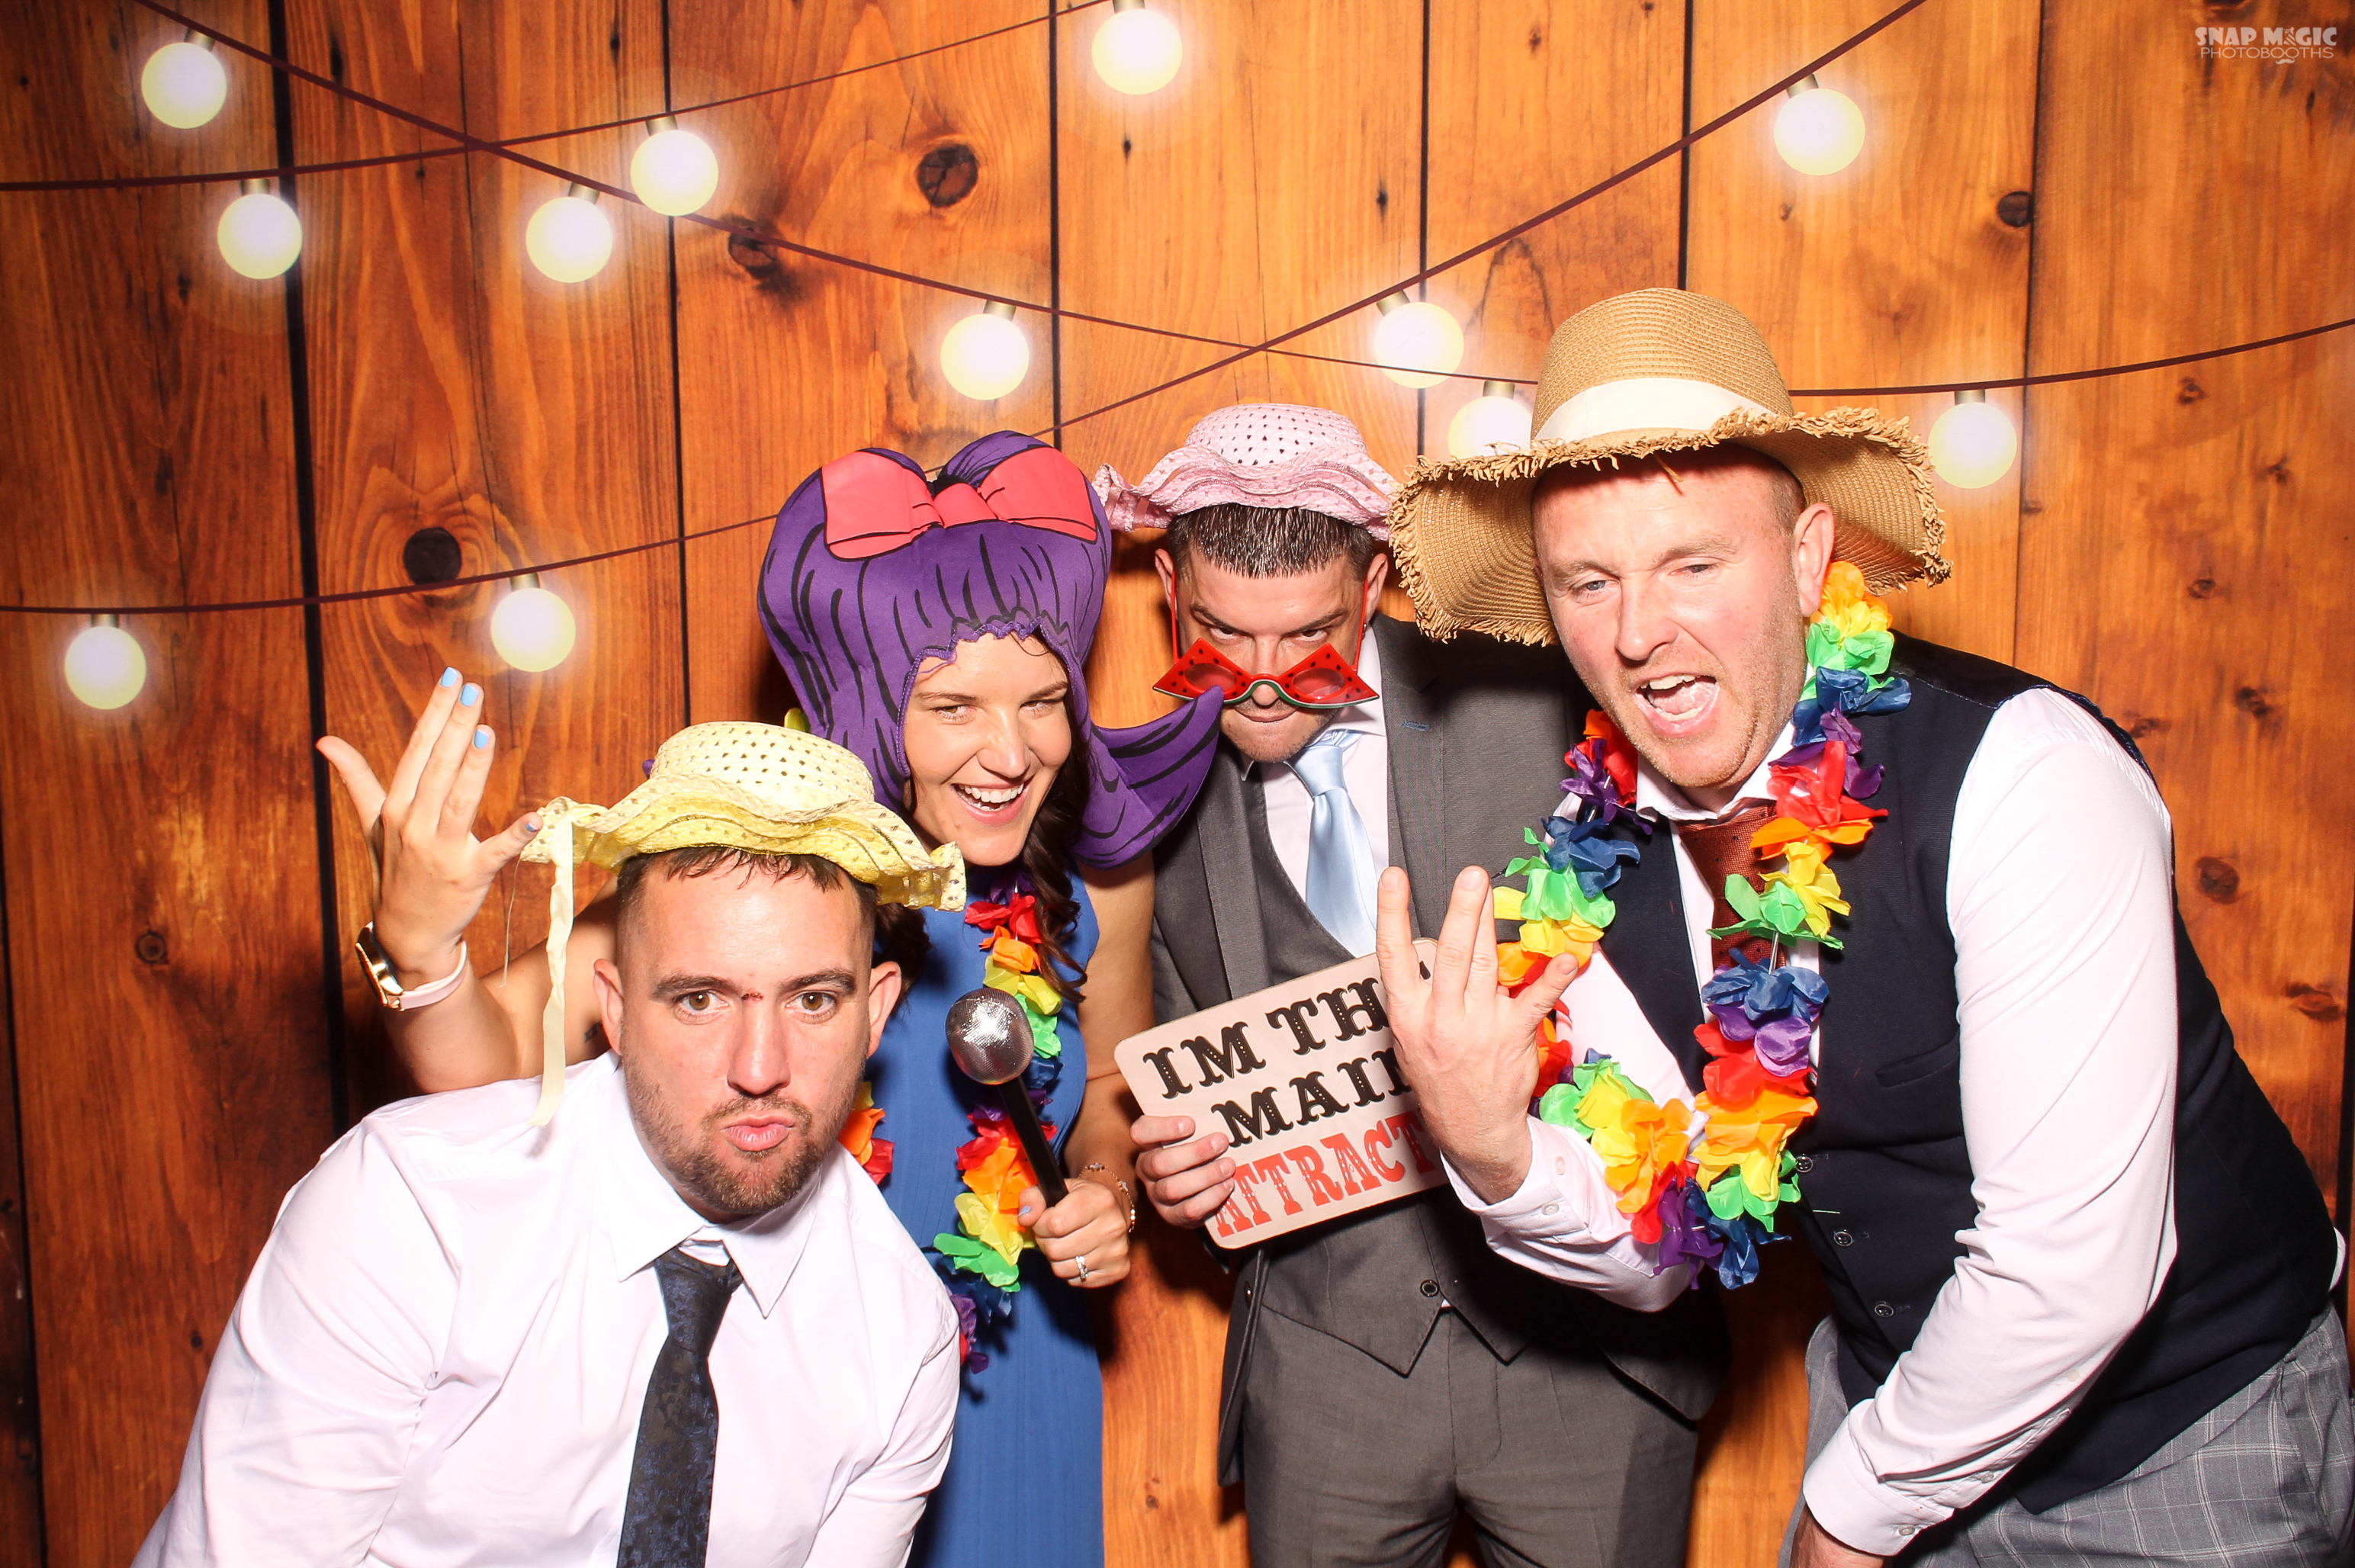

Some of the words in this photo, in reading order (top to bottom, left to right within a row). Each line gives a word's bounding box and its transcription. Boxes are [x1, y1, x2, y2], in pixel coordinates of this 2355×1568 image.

[1142, 1021, 1267, 1099] IM
[1264, 959, 1431, 1056] TH
[1214, 1109, 1437, 1239] ATTRACT
